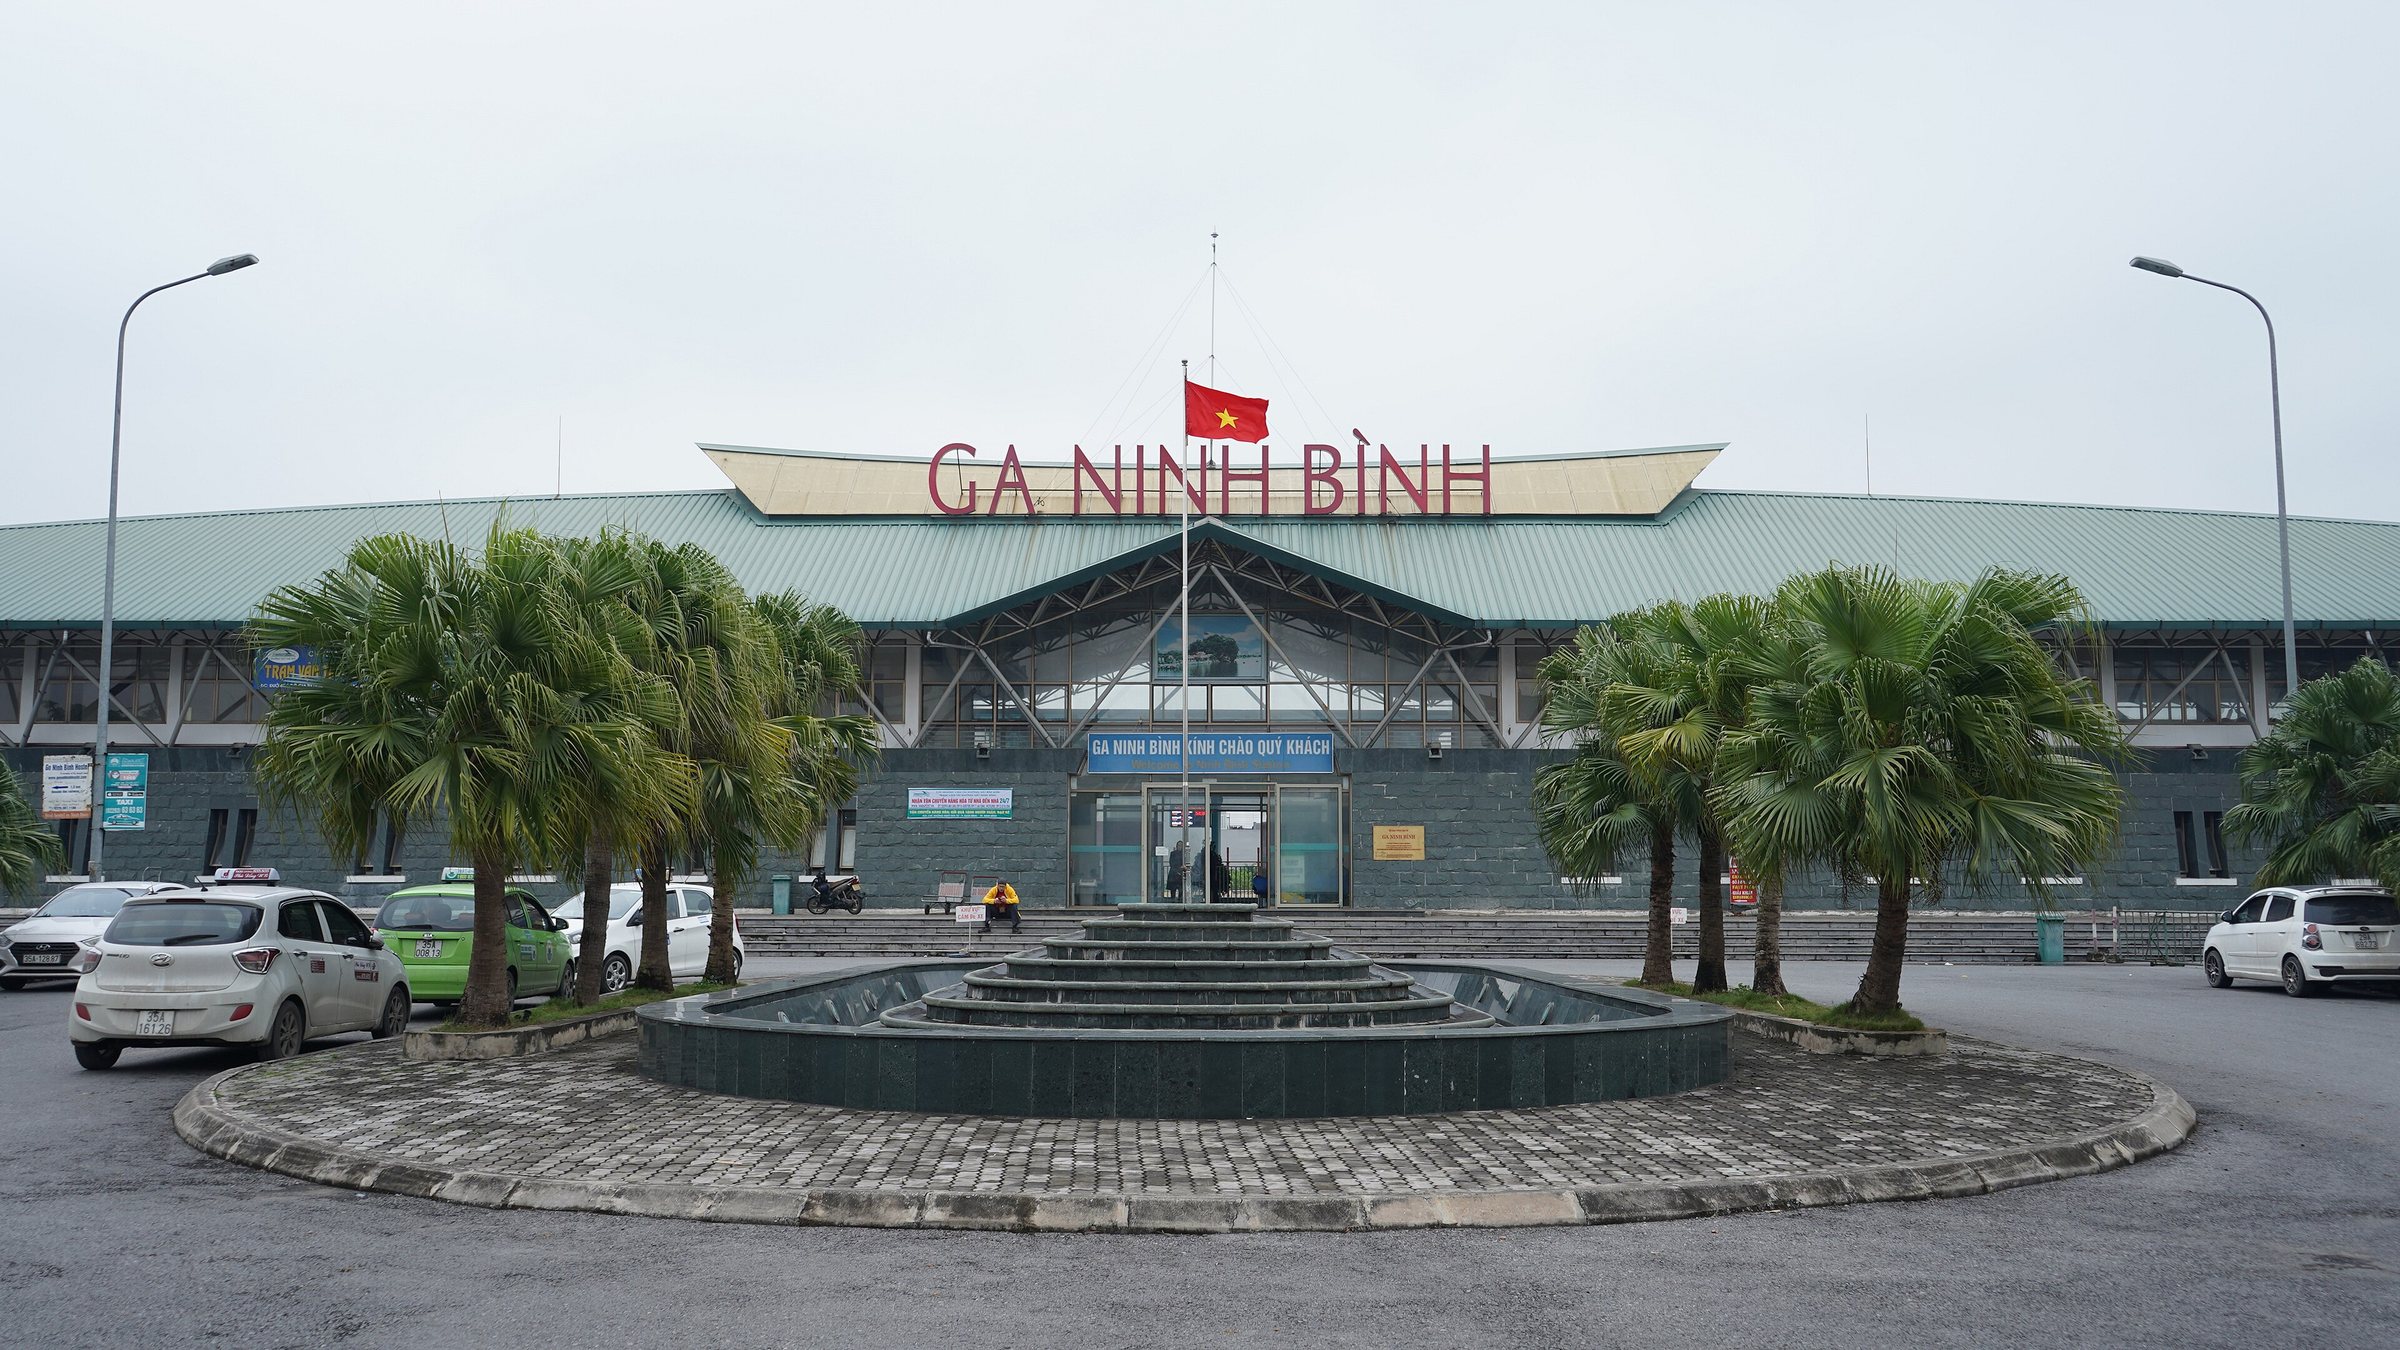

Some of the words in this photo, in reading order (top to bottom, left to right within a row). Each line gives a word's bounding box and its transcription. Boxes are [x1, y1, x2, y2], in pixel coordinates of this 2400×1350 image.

[929, 442, 1035, 515] GA
[1074, 444, 1269, 515] NINH
[1304, 428, 1491, 515] BÌNH
[1092, 739, 1110, 755] GA
[1113, 739, 1146, 755] NINH
[1150, 736, 1180, 755] BÌNH
[1188, 736, 1214, 755] KÍNH
[1219, 736, 1253, 755] CHÀO
[1258, 736, 1282, 757] QUÝ
[1286, 736, 1330, 755] KHÁCH
[423, 940, 435, 948] 35A
[147, 1012, 165, 1022] 35A
